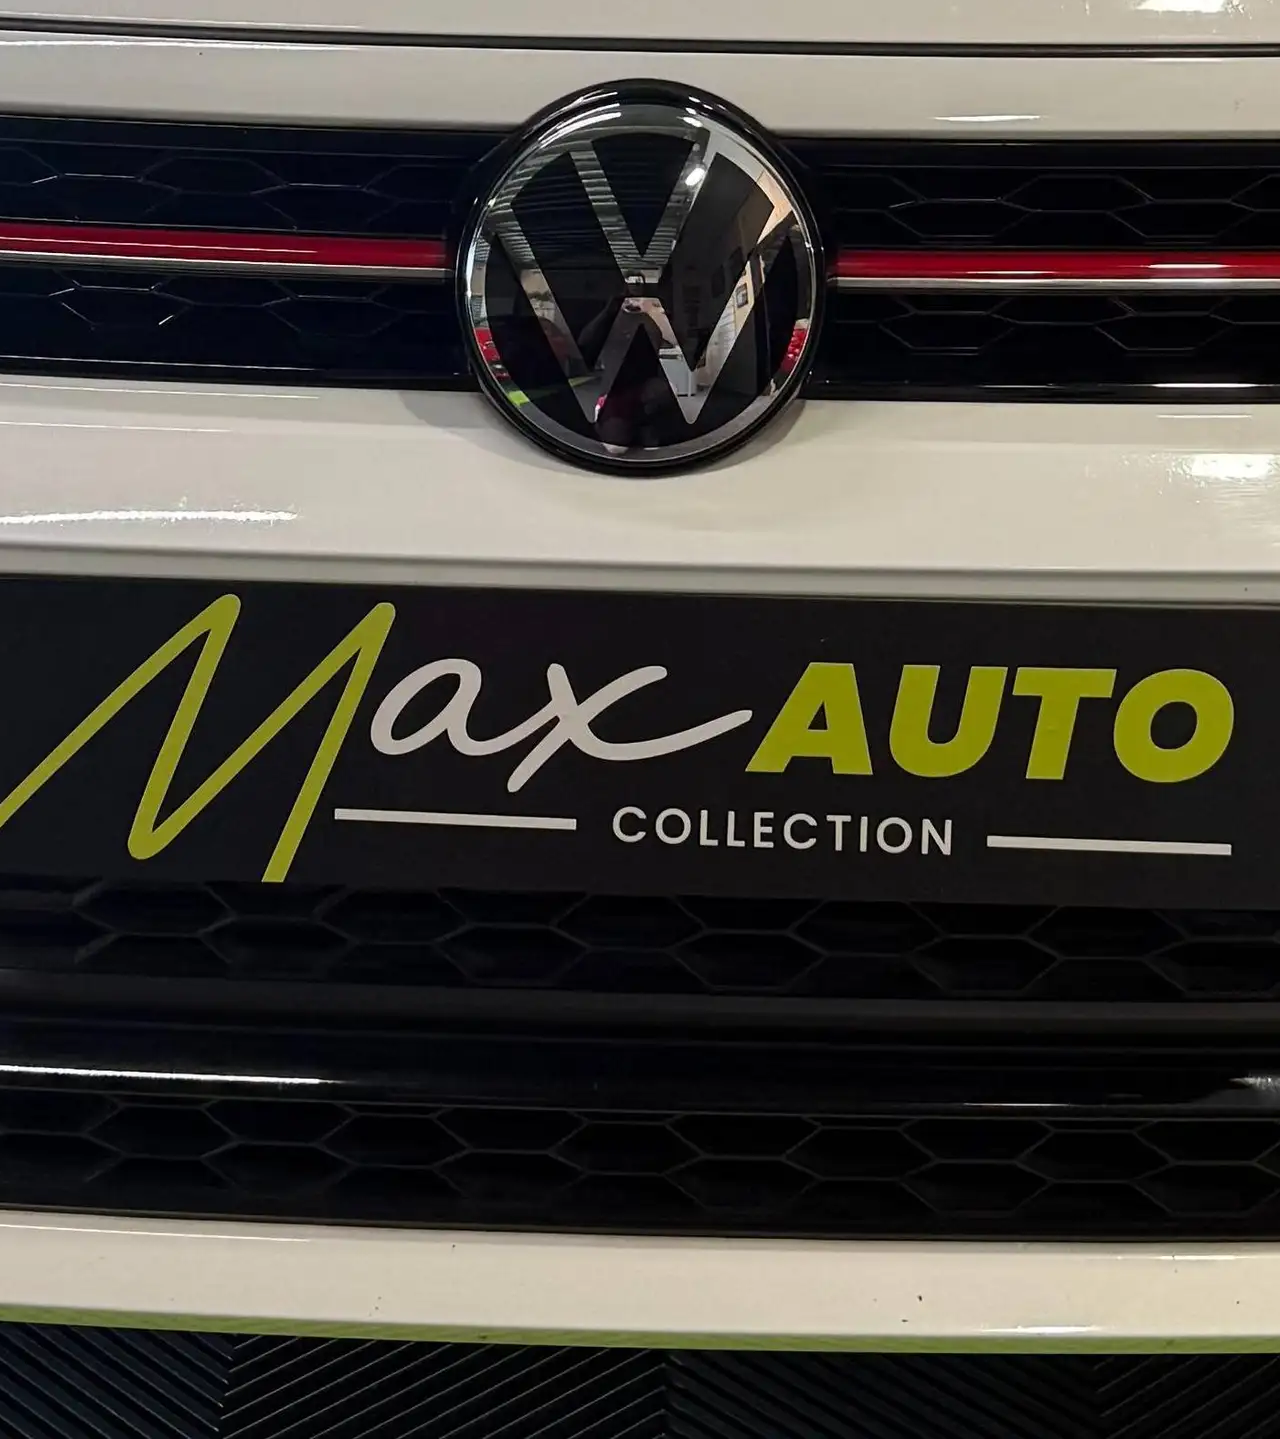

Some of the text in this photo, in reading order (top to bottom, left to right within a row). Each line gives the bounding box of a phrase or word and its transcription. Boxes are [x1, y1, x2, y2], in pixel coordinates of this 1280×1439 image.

[472, 113, 810, 445] VW
[745, 661, 1235, 783] AUTO
[612, 806, 953, 856] COLLECTION
